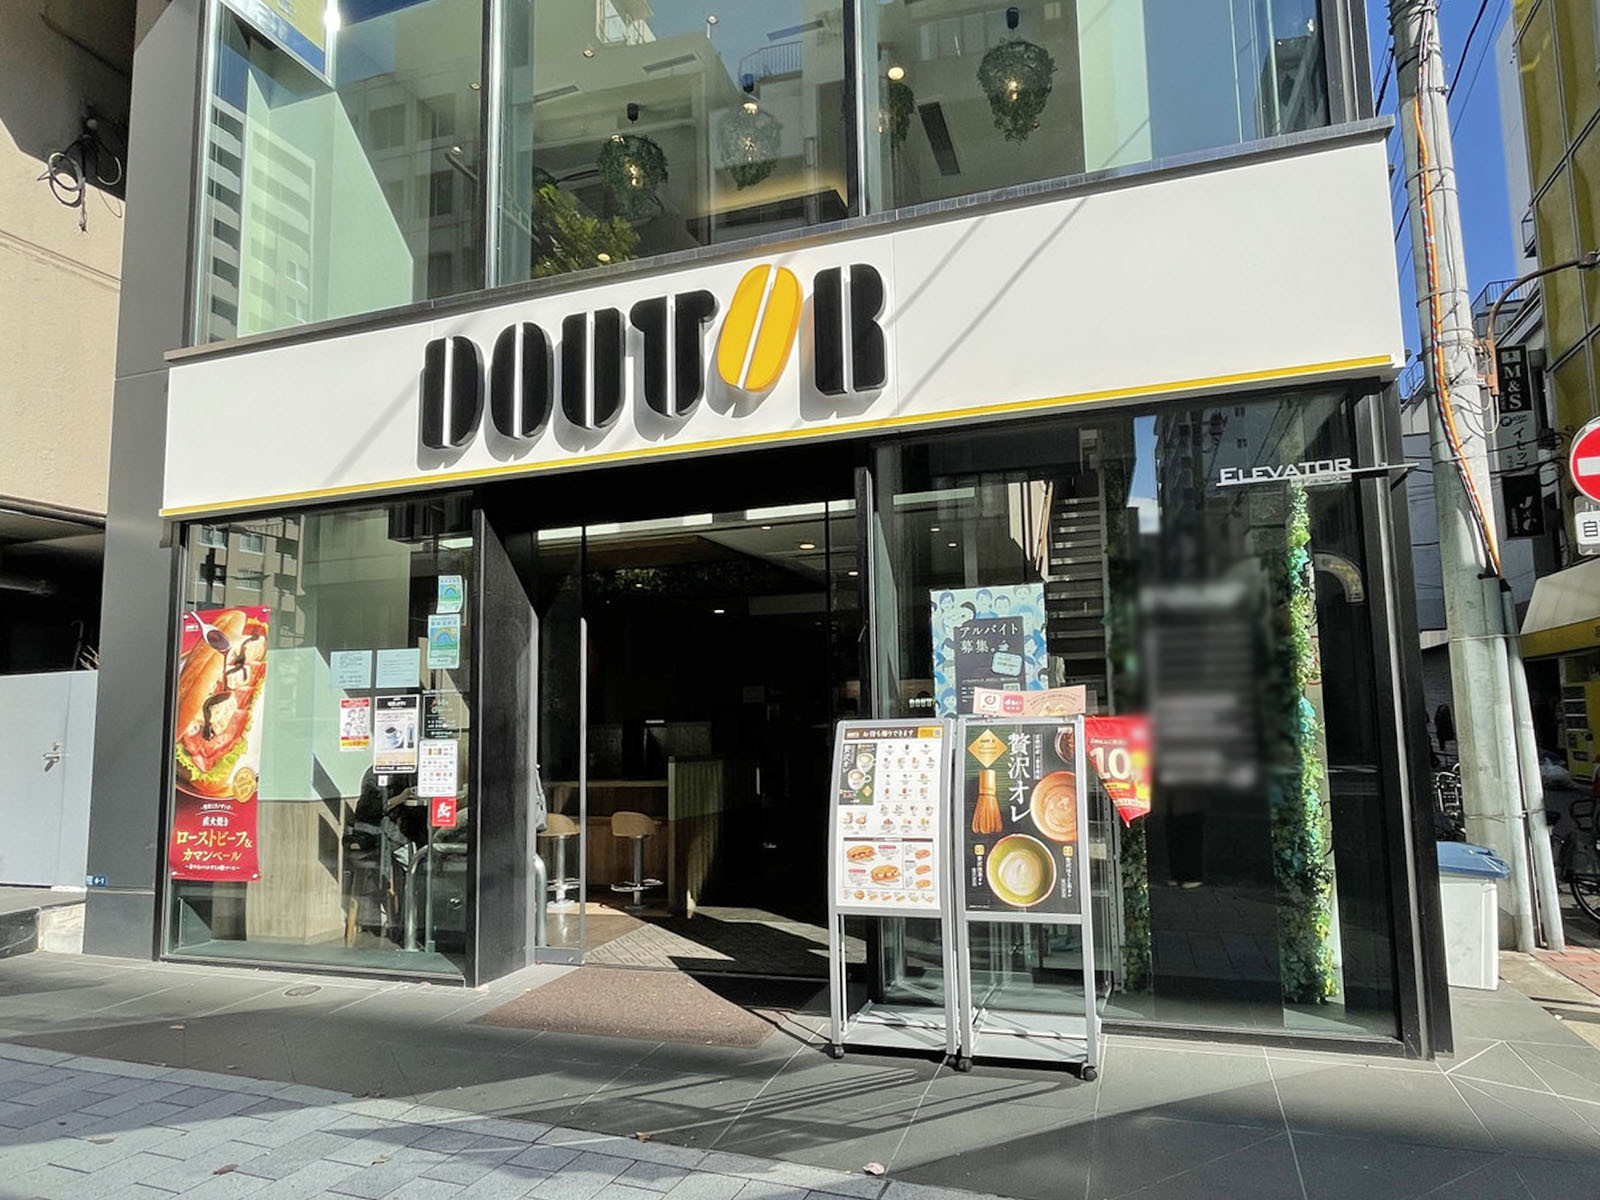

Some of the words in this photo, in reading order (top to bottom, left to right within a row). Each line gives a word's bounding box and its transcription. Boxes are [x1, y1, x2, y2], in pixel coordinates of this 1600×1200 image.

[421, 263, 889, 451] DOUTOR
[1503, 365, 1522, 409] M&S
[1219, 458, 1352, 484] ELEVATOR
[959, 622, 1018, 638] アルバイト
[1007, 732, 1031, 822] 贅沢オレ
[182, 848, 243, 863] カマンベール
